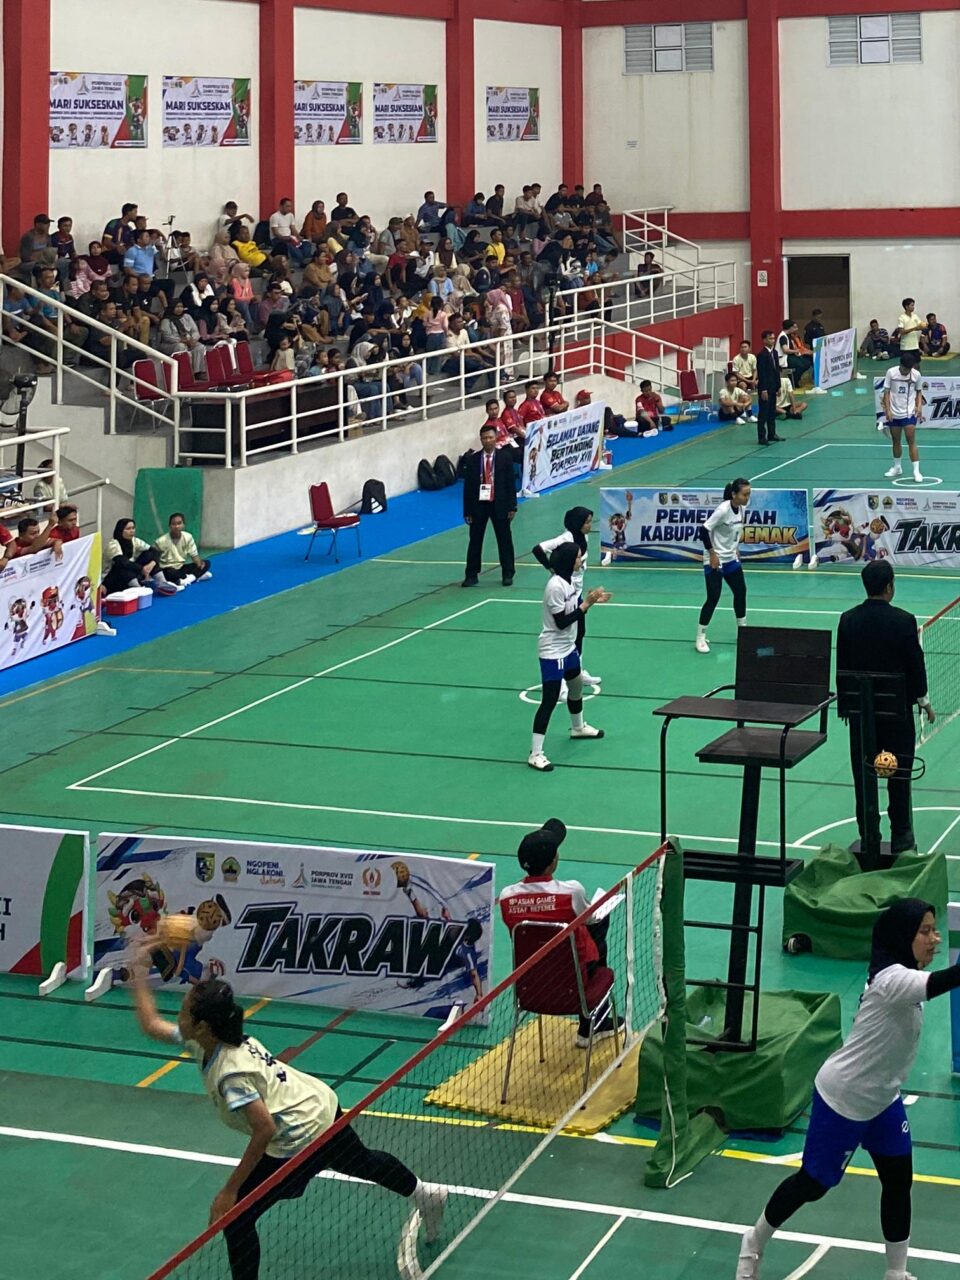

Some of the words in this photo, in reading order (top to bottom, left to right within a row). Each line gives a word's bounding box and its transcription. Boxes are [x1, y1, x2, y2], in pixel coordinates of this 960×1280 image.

[73, 99, 124, 110] SUKSESKAN
[165, 101, 186, 110] MARI
[187, 101, 231, 111] SUKSESKAN
[308, 103, 345, 112] SUKSESKAN
[390, 104, 423, 112] SUKSESKAN
[550, 437, 594, 463] BERTANDING
[311, 870, 339, 878] PORPROV
[328, 878, 352, 886] TENGAH
[237, 902, 469, 978] TAKRAW
